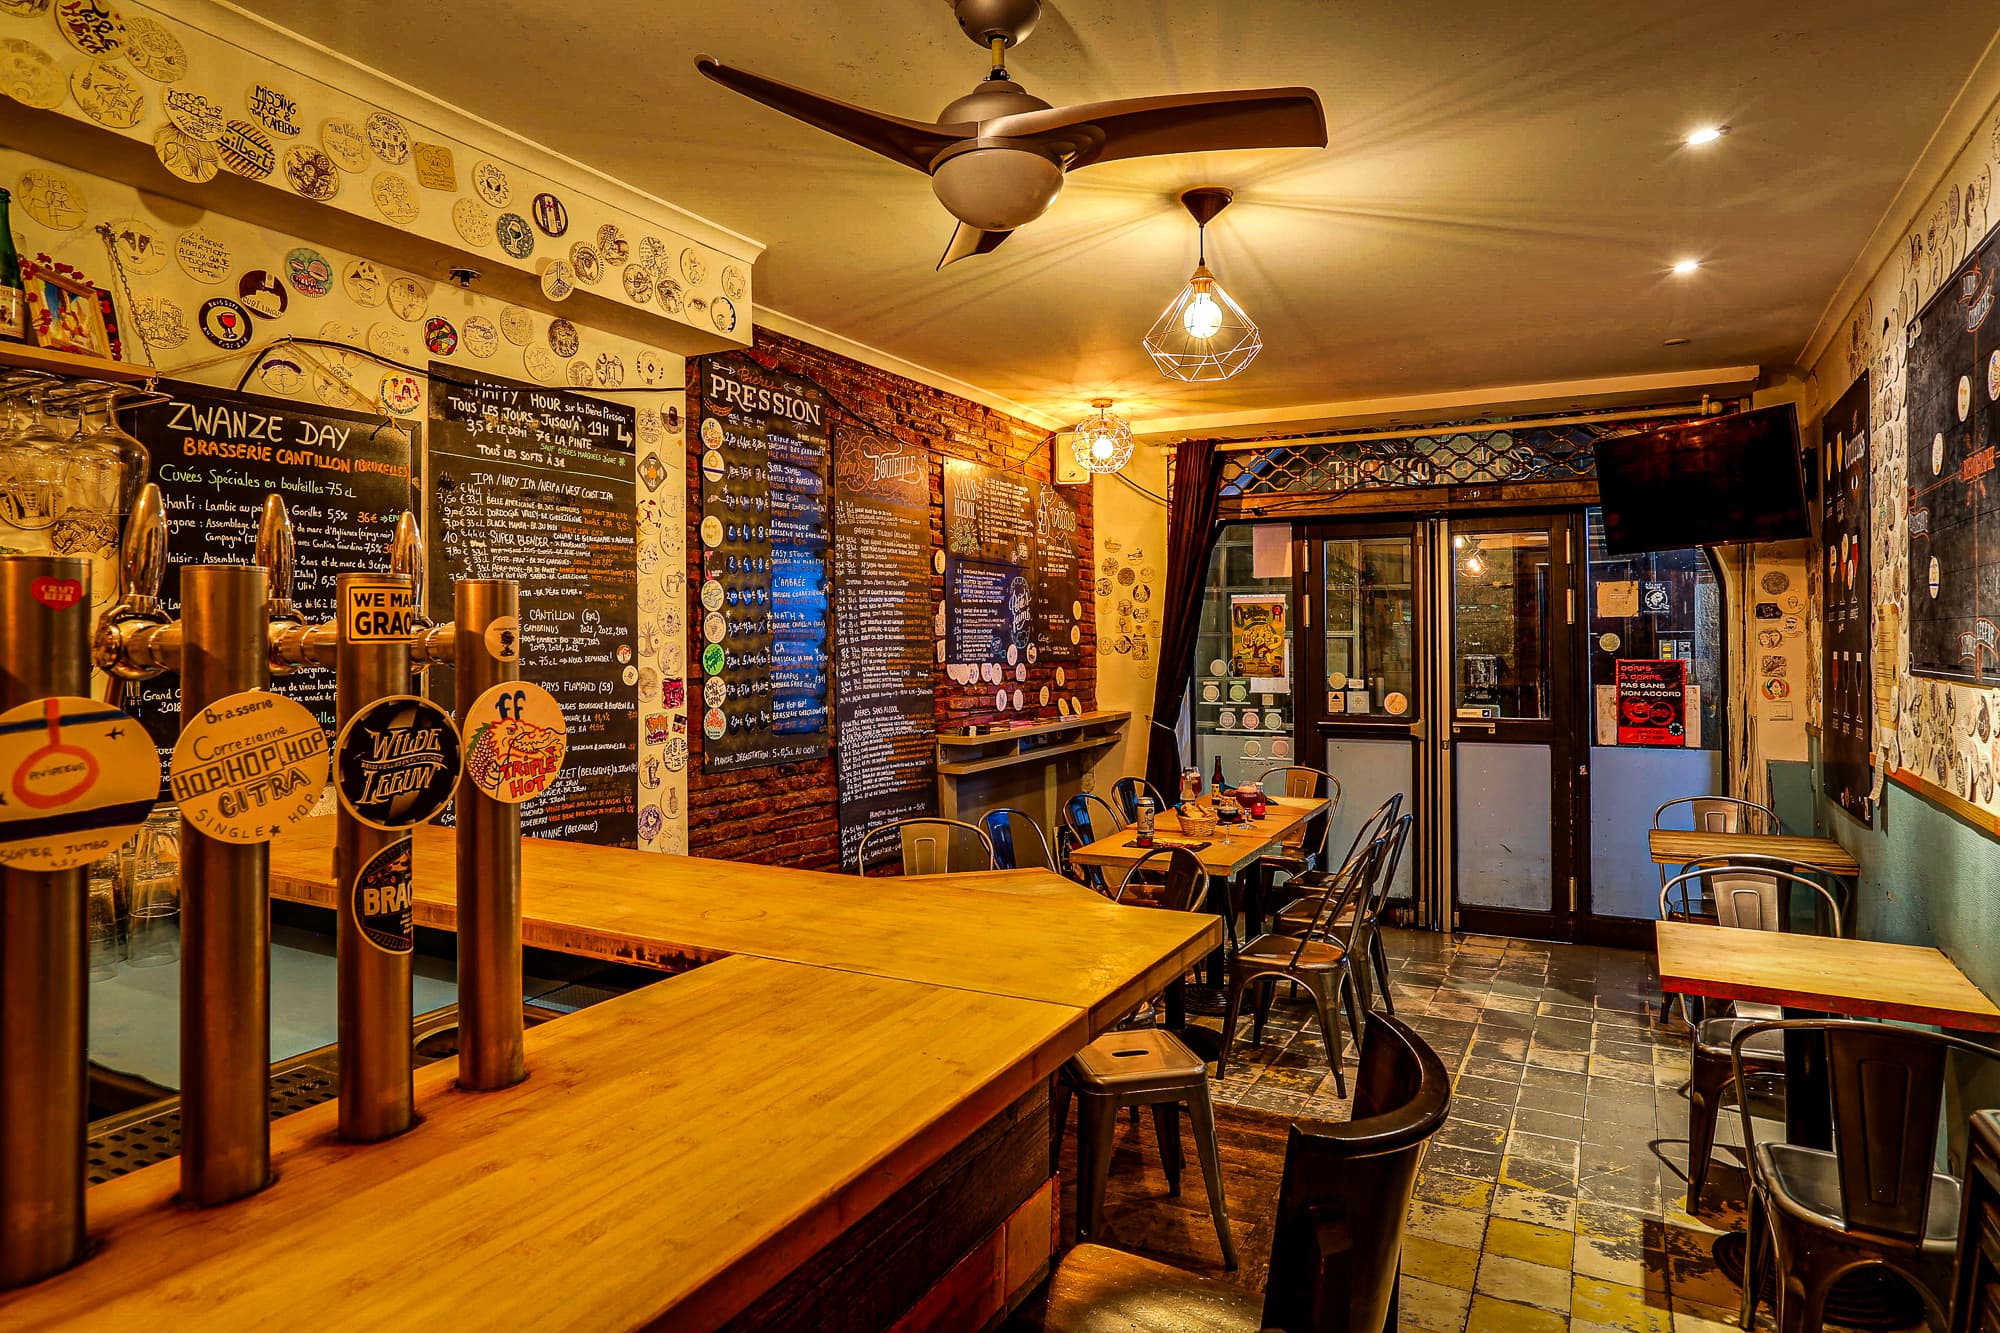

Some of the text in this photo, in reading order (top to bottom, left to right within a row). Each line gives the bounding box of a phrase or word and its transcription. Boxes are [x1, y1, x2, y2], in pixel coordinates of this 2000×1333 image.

[448, 397, 478, 413] TOUS
[482, 403, 499, 418] LES
[502, 406, 533, 423] JOURS
[530, 394, 561, 412] HOUR
[709, 373, 822, 426] PRESSION
[166, 401, 351, 452] ZWANZE DAY
[275, 449, 351, 474] CANTILLON
[503, 448, 518, 460] LES
[159, 463, 203, 484] Cuvées
[208, 468, 261, 493] Spéciales
[264, 478, 277, 489] en
[281, 478, 324, 495] bouteilles
[204, 499, 238, 513] Lambic
[353, 593, 388, 608] WE
[143, 689, 172, 702] Grand
[203, 698, 274, 725] Brasserie
[230, 748, 277, 781] HOP
[282, 731, 325, 763] HOP
[364, 726, 443, 763] WILDE
[354, 766, 440, 805] LEEUW
[509, 775, 546, 800] HOT
[194, 792, 315, 840] SINGLE HOP
